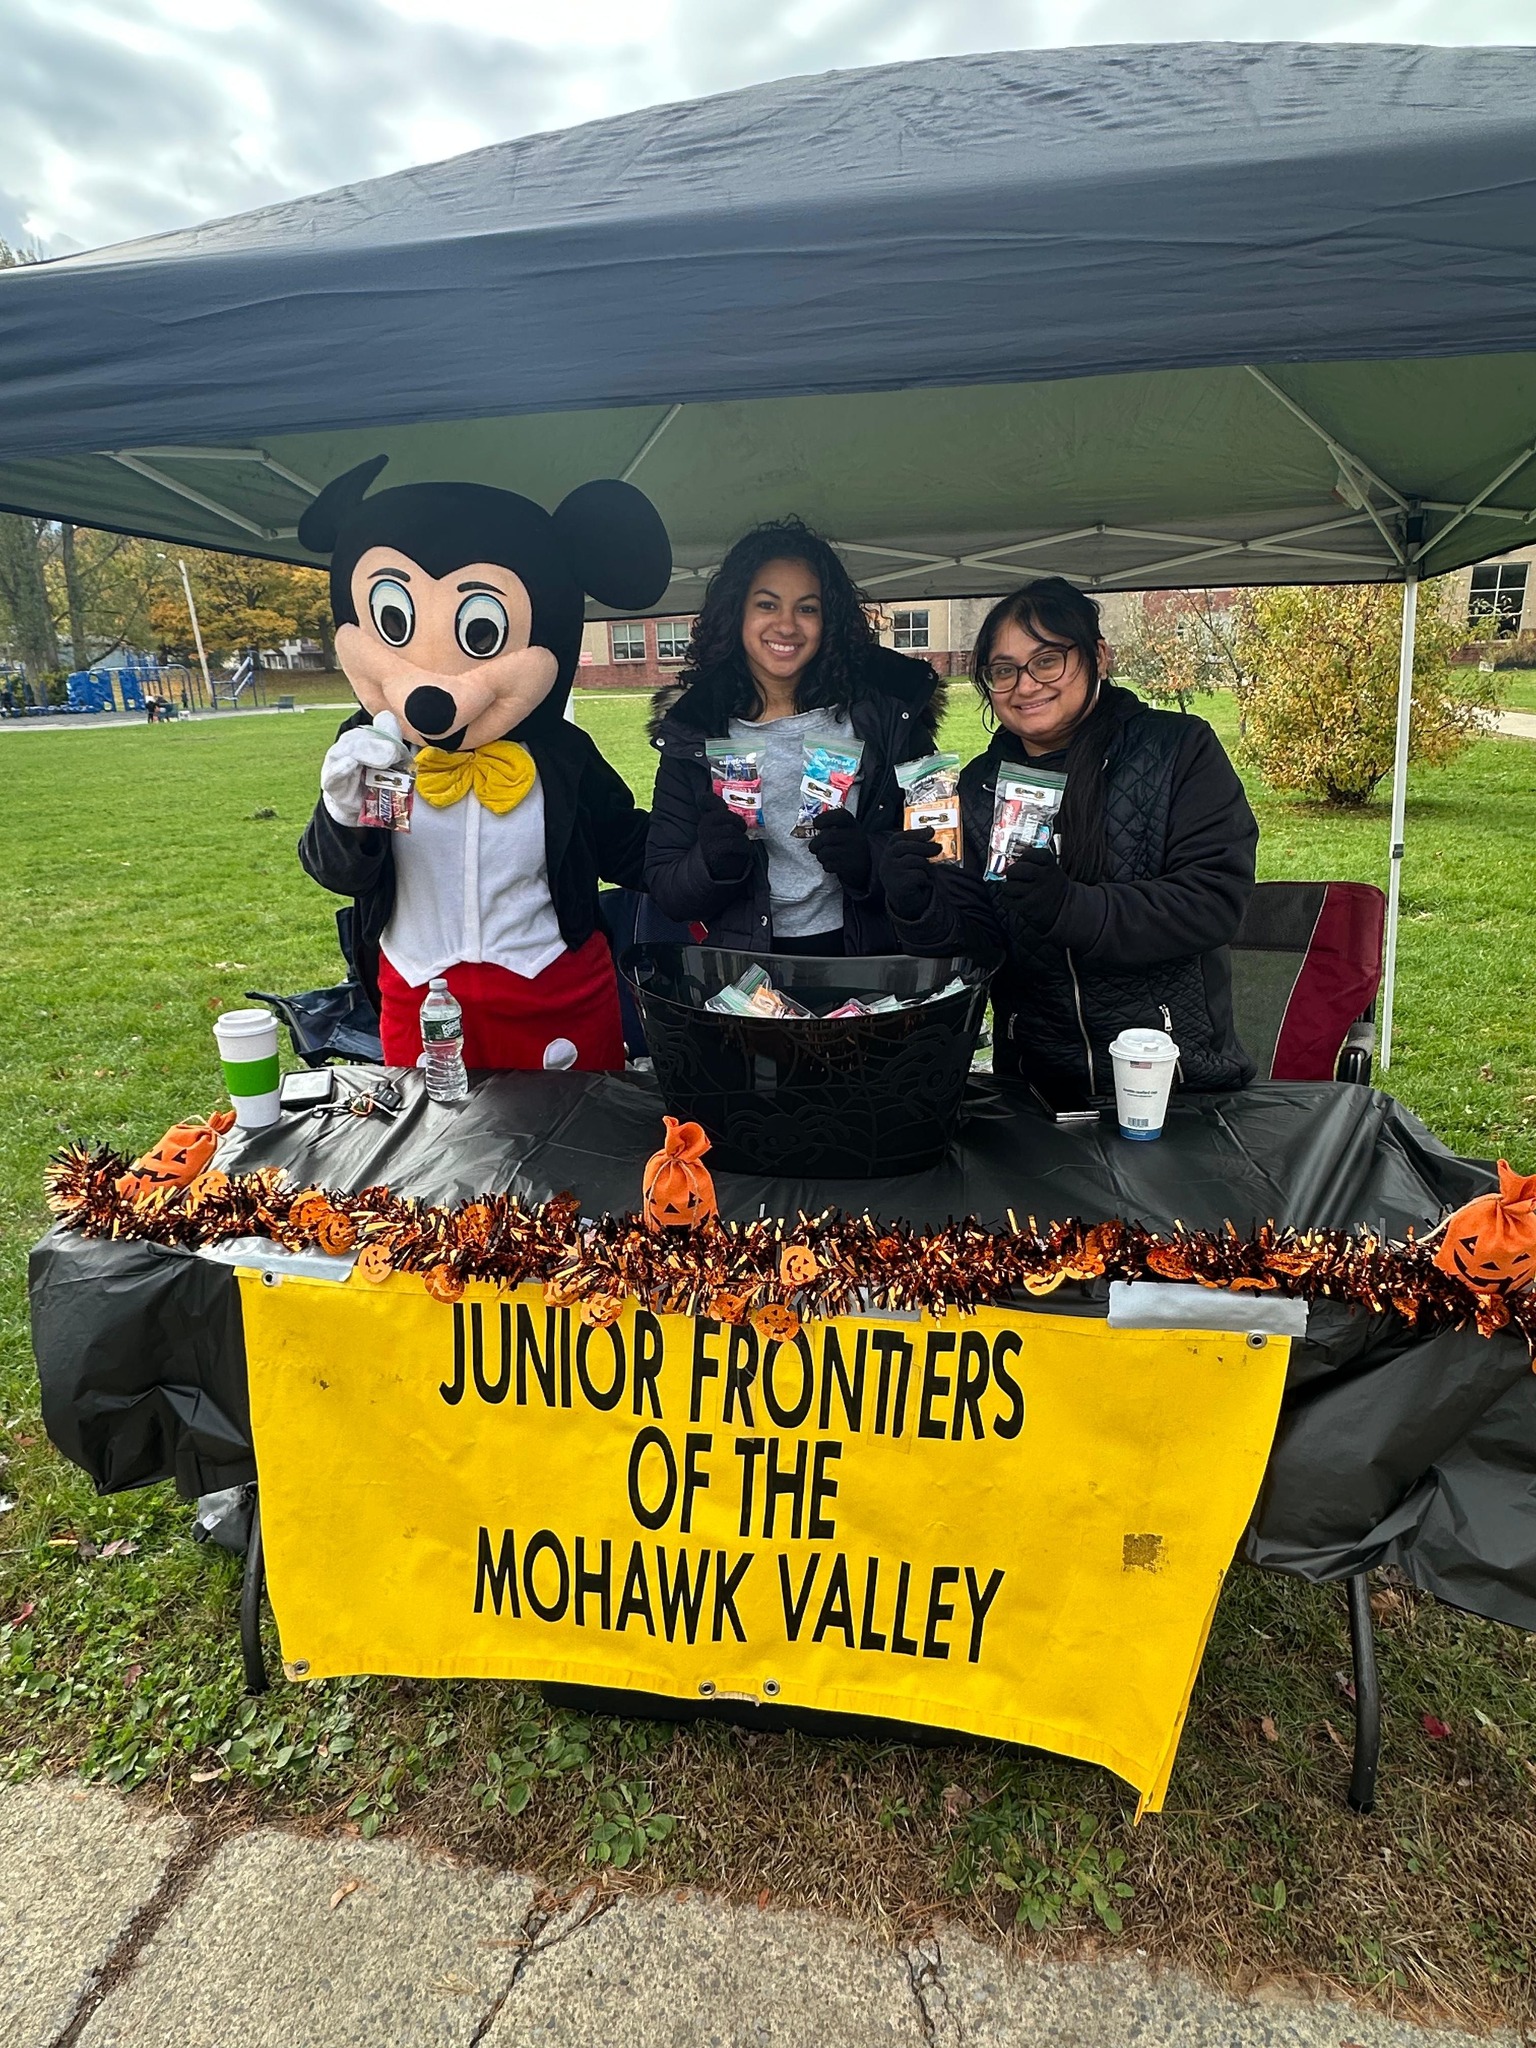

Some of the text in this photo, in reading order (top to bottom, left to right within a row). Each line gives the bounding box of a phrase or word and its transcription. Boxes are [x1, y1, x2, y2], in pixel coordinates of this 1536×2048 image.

[438, 1302, 1025, 1441] JUNIOR FRONTIERS
[628, 1425, 843, 1540] OF THE
[473, 1526, 1006, 1664] MOHAWK VALLEY
